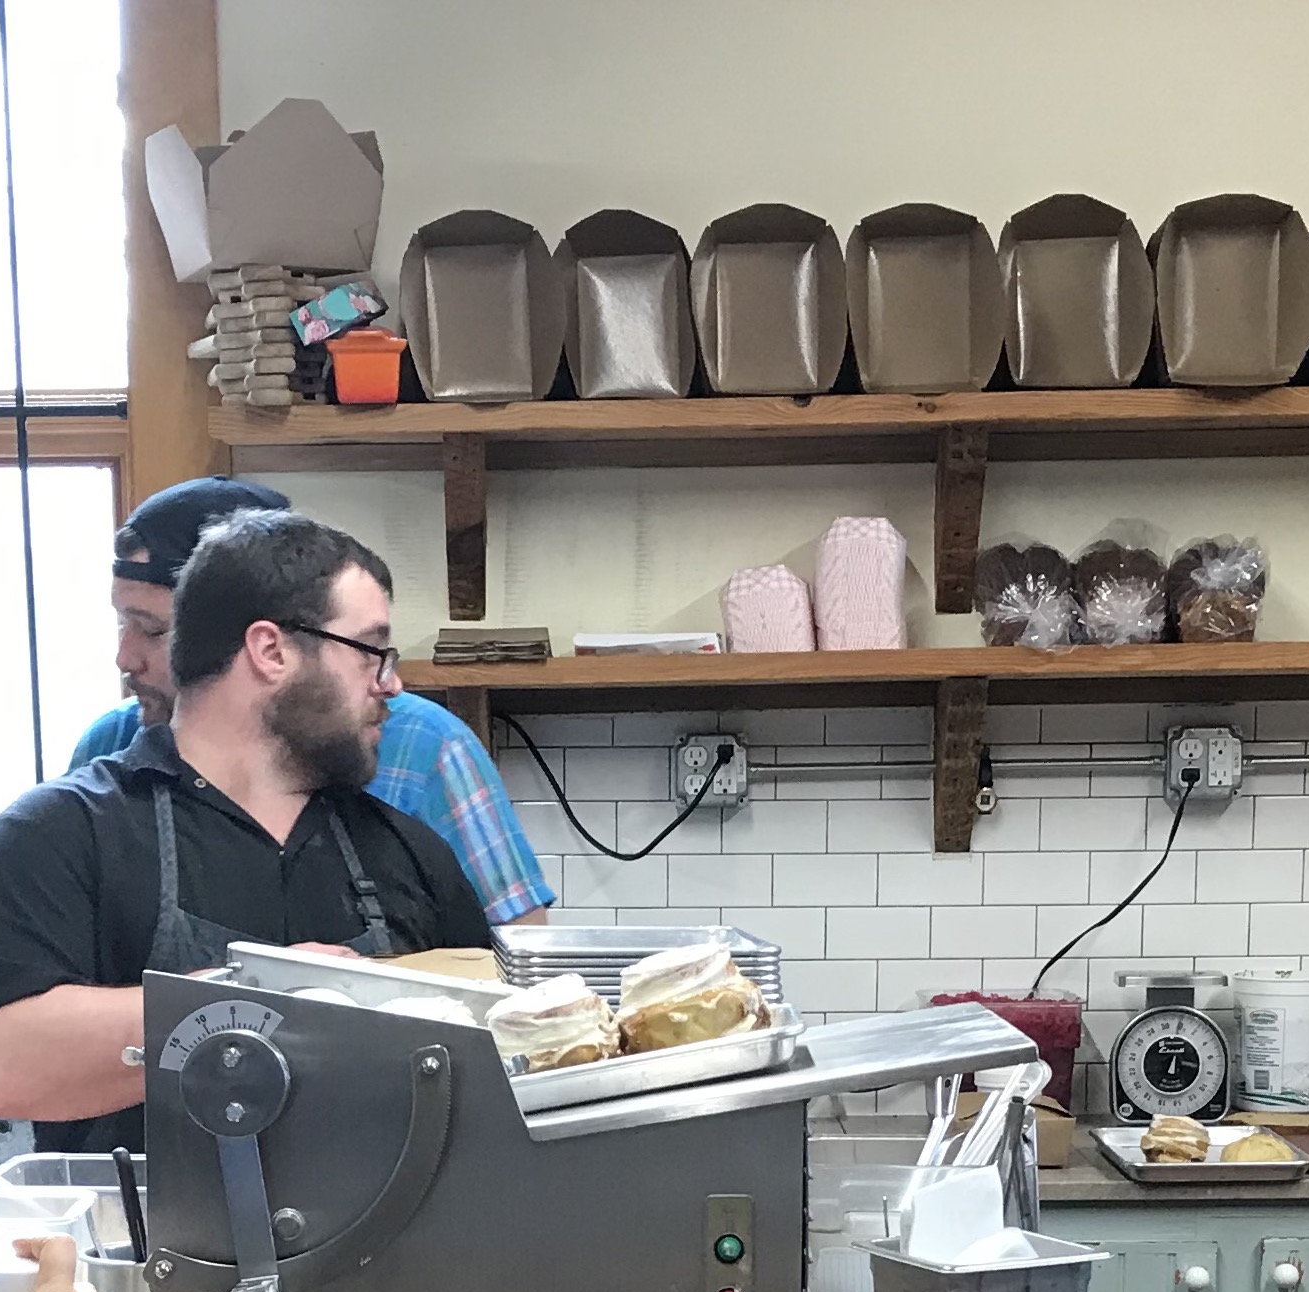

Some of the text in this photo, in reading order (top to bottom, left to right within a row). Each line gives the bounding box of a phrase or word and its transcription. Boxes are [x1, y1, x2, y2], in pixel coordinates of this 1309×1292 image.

[230, 1006, 236, 1015] 5
[195, 1014, 207, 1024] 10
[264, 1012, 271, 1020] 0
[169, 1037, 180, 1048] 15
